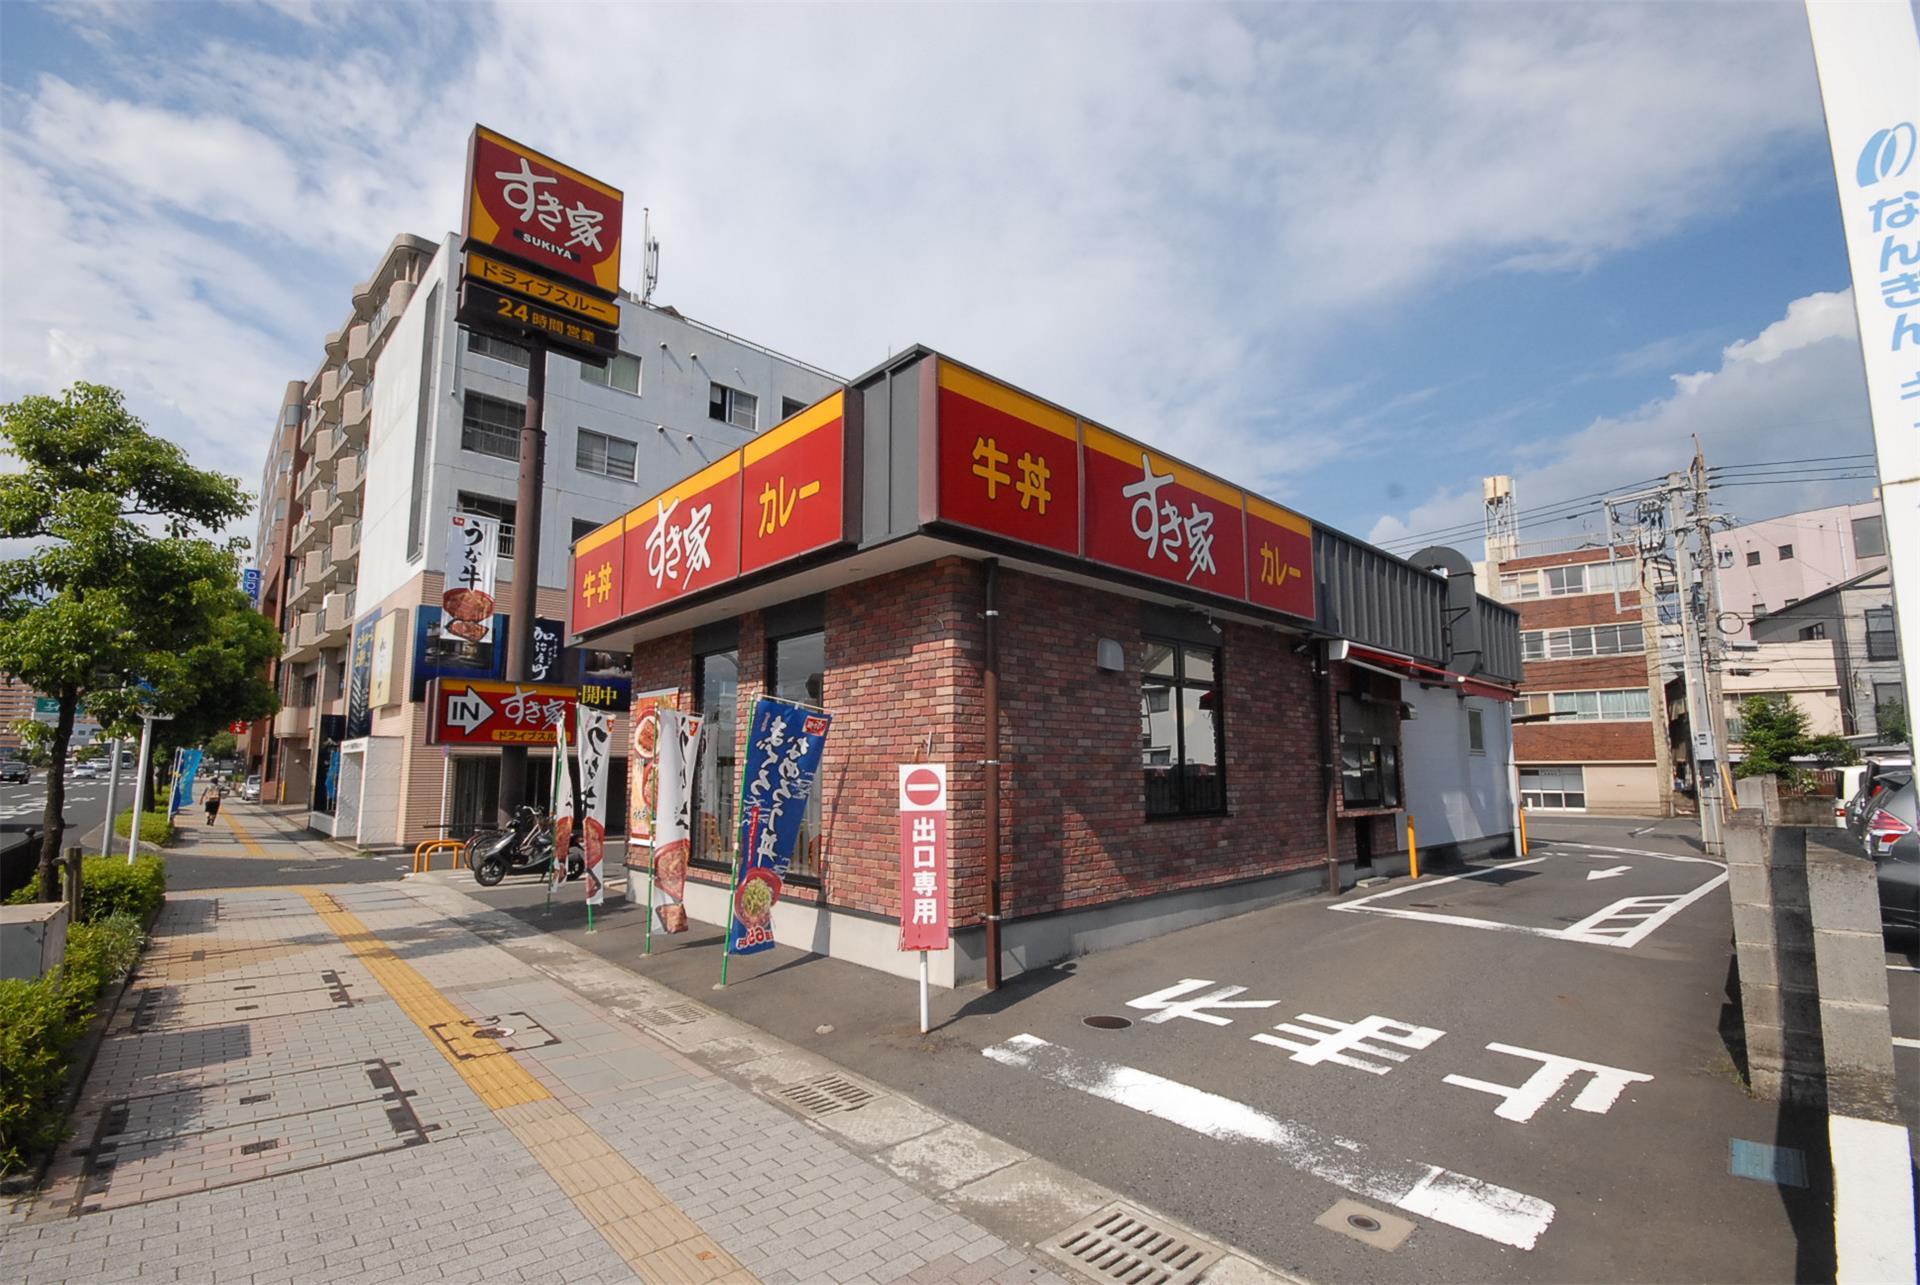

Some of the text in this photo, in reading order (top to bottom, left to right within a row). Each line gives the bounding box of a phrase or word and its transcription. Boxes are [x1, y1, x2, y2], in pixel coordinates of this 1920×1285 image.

[495, 158, 603, 252] すき家
[523, 233, 573, 260] SUKIYA
[483, 261, 606, 314] ドライブスルー
[497, 298, 596, 344] 24時間営業
[972, 436, 1052, 515] 牛丼
[758, 475, 821, 538] カレー
[1122, 452, 1217, 581] すき家
[458, 520, 484, 591] うな牛
[645, 496, 712, 590] すき家
[1260, 541, 1302, 587] カレー
[582, 561, 613, 608] 牛丼
[452, 701, 480, 720] IN
[500, 685, 566, 730] すき家
[578, 685, 617, 705] 開中
[499, 729, 558, 741] ドライブスル
[912, 817, 938, 925] 出口専用
[1126, 978, 1654, 1123] 止まれ
